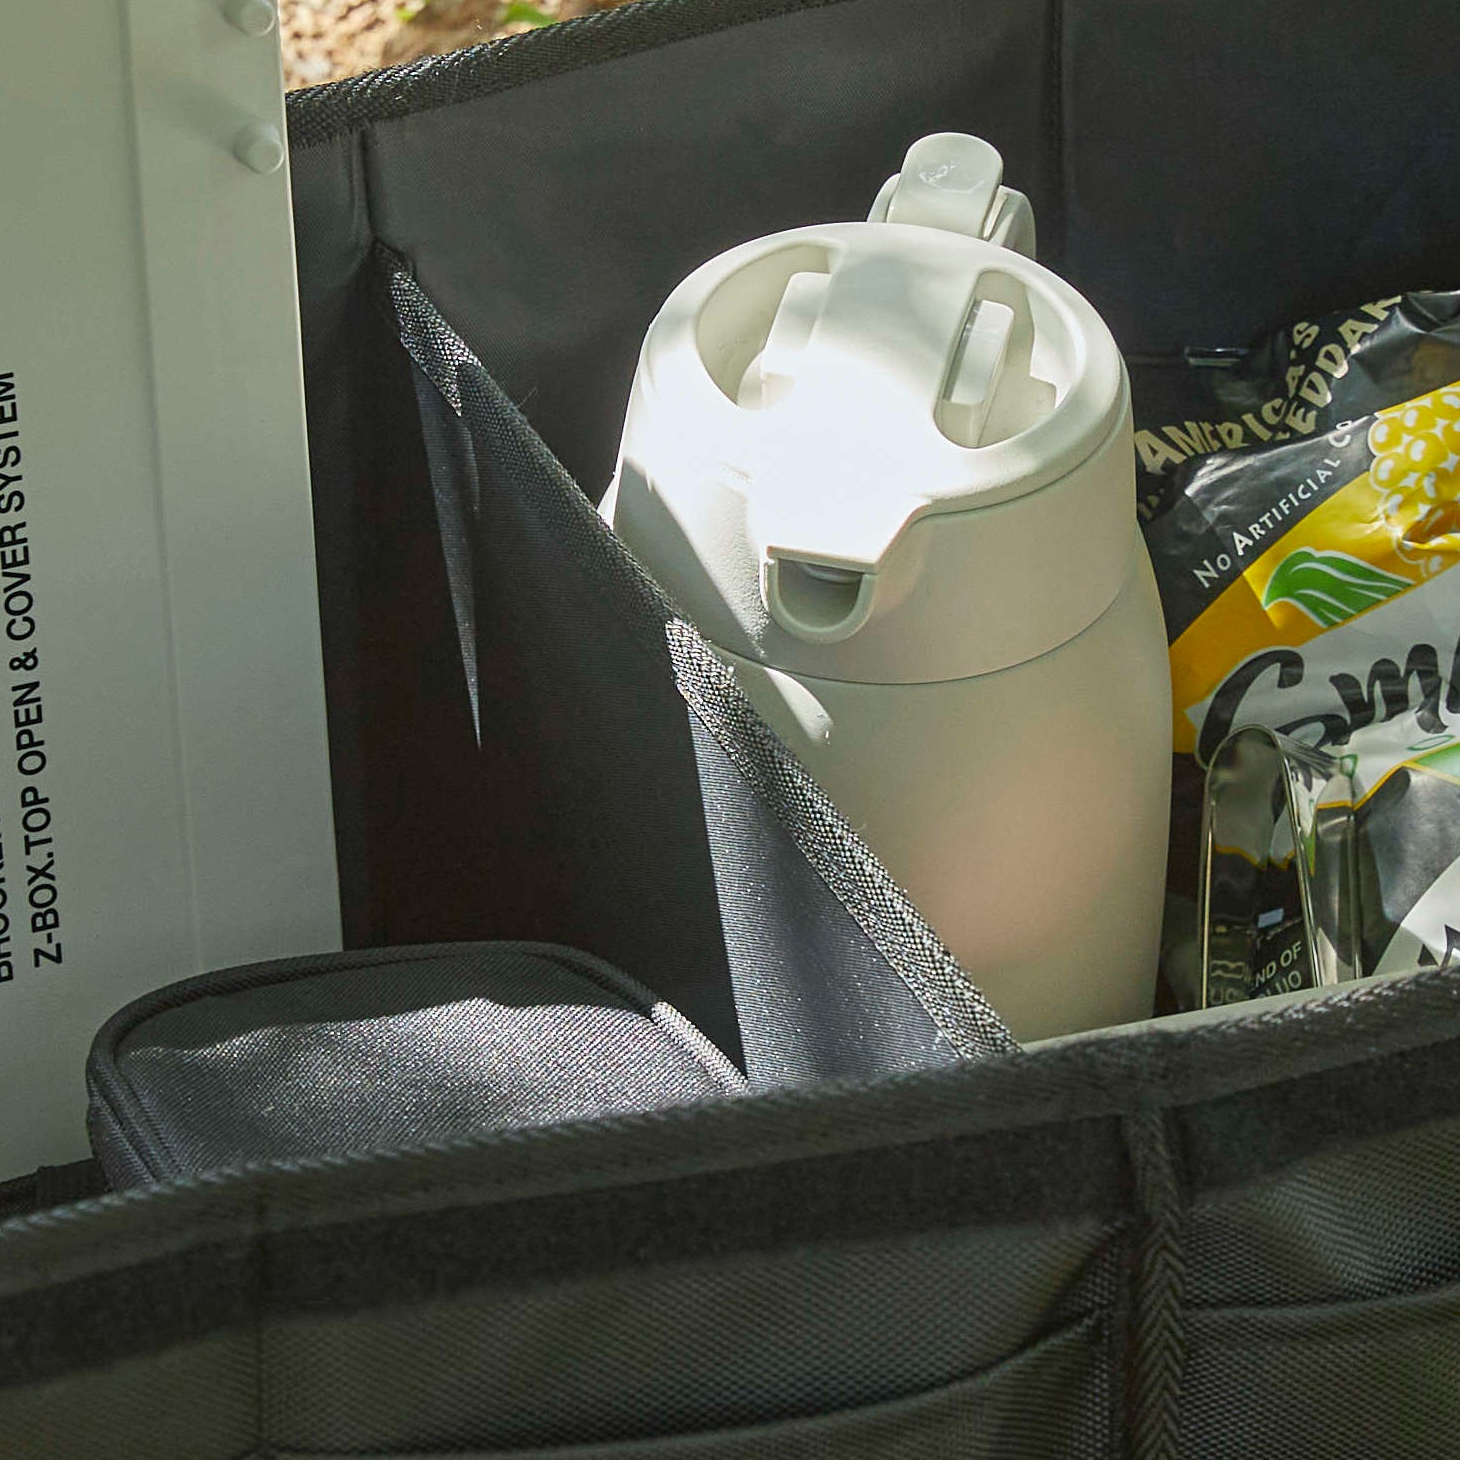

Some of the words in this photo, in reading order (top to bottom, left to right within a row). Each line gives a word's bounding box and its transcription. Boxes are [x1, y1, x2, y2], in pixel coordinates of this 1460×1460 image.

[8, 646, 39, 672] &
[11, 680, 47, 776] OPEN
[20, 785, 63, 969] Z-BOX.TOP
